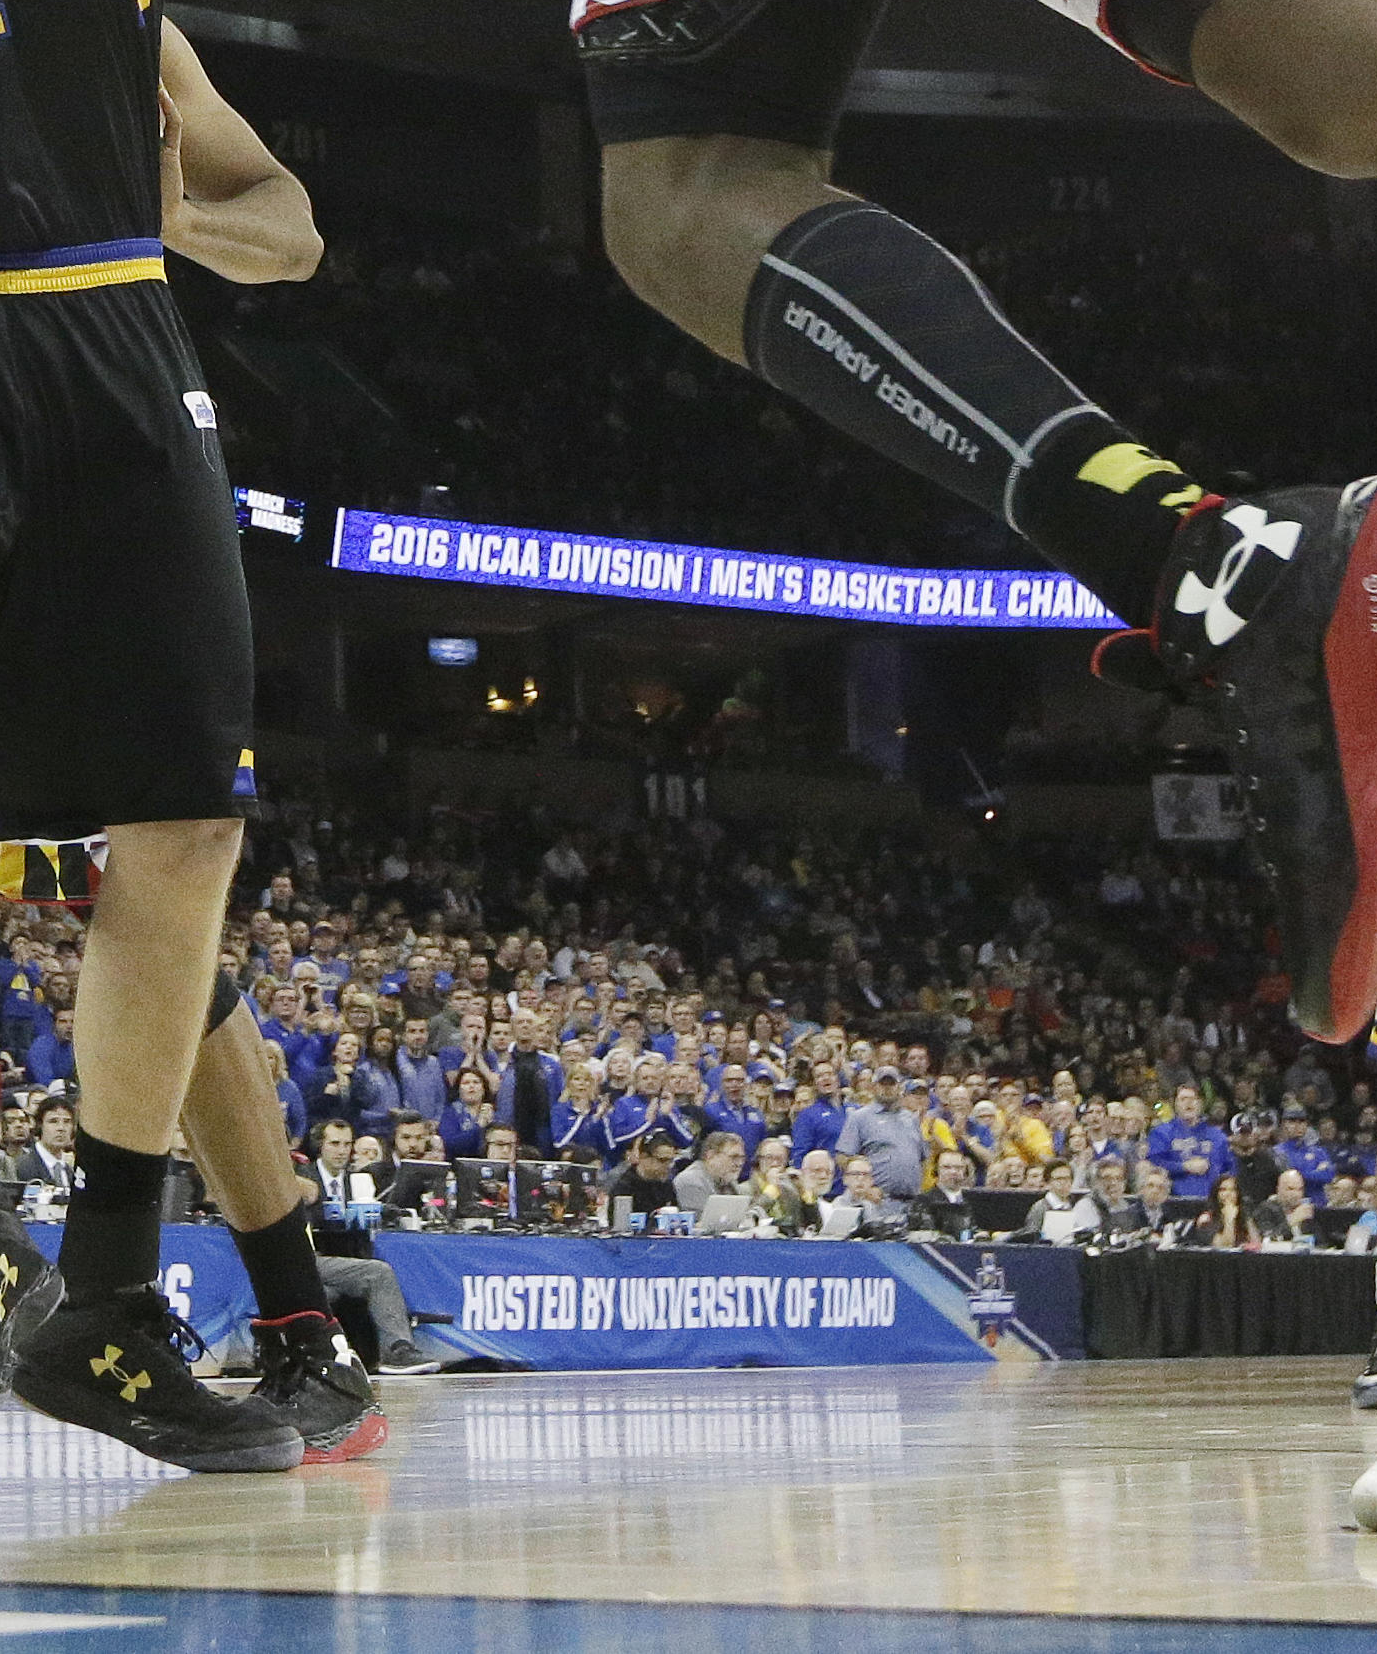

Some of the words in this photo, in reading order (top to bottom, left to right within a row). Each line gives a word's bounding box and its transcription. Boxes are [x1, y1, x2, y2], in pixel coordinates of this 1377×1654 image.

[783, 300, 880, 383] ARMOUR
[874, 374, 962, 451] UNDER
[369, 523, 450, 568] 2016
[456, 532, 540, 578] NCAA
[547, 541, 685, 591] DIVISION
[708, 558, 804, 604] MEN'S
[810, 569, 998, 618] BASKETBALL
[1007, 579, 1115, 619] CHAM
[462, 1275, 577, 1331] HOSTED
[580, 1277, 616, 1330] BY
[620, 1276, 781, 1330] UNIVERSITY
[784, 1277, 819, 1328] OF
[820, 1277, 896, 1328] IDAHO
